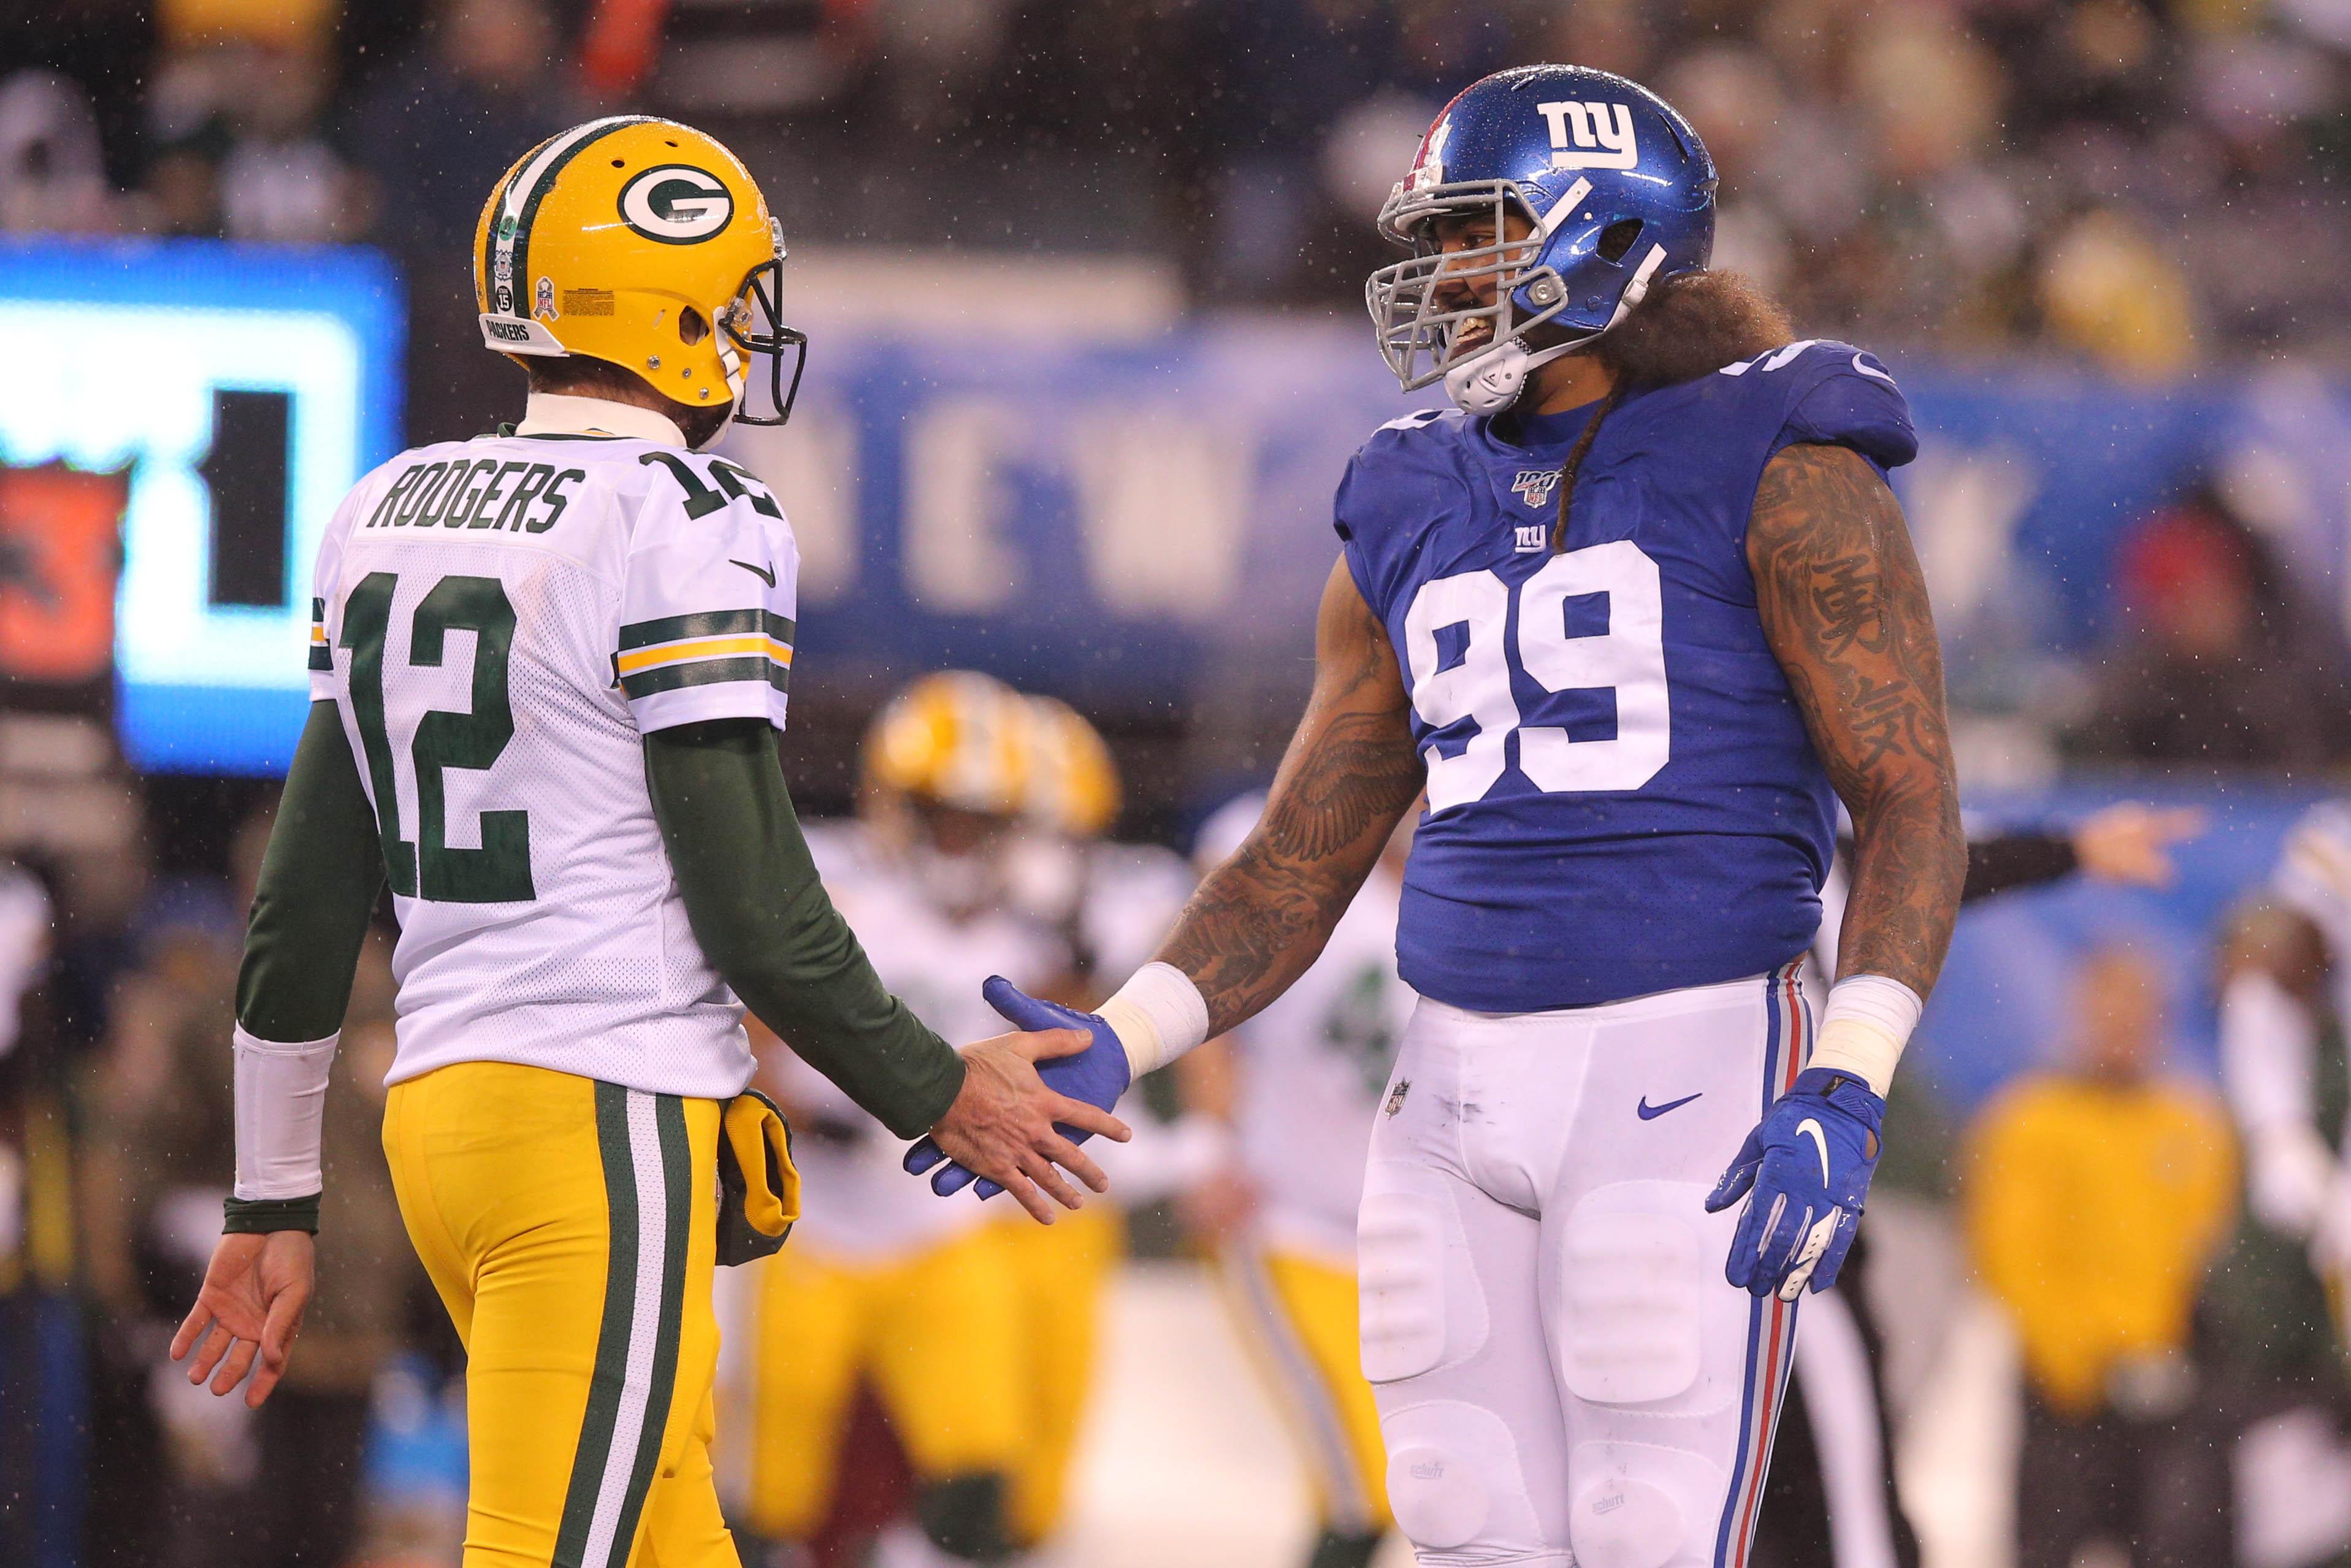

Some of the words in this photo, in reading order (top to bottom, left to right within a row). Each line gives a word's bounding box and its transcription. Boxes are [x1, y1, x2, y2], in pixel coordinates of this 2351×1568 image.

[622, 168, 731, 239] G
[486, 319, 530, 341] PACKERS
[499, 294, 510, 308] 15
[366, 458, 586, 534] RODGERS
[1528, 492, 1544, 503] NFL
[1404, 540, 1670, 816] 99
[338, 572, 537, 903] 12
